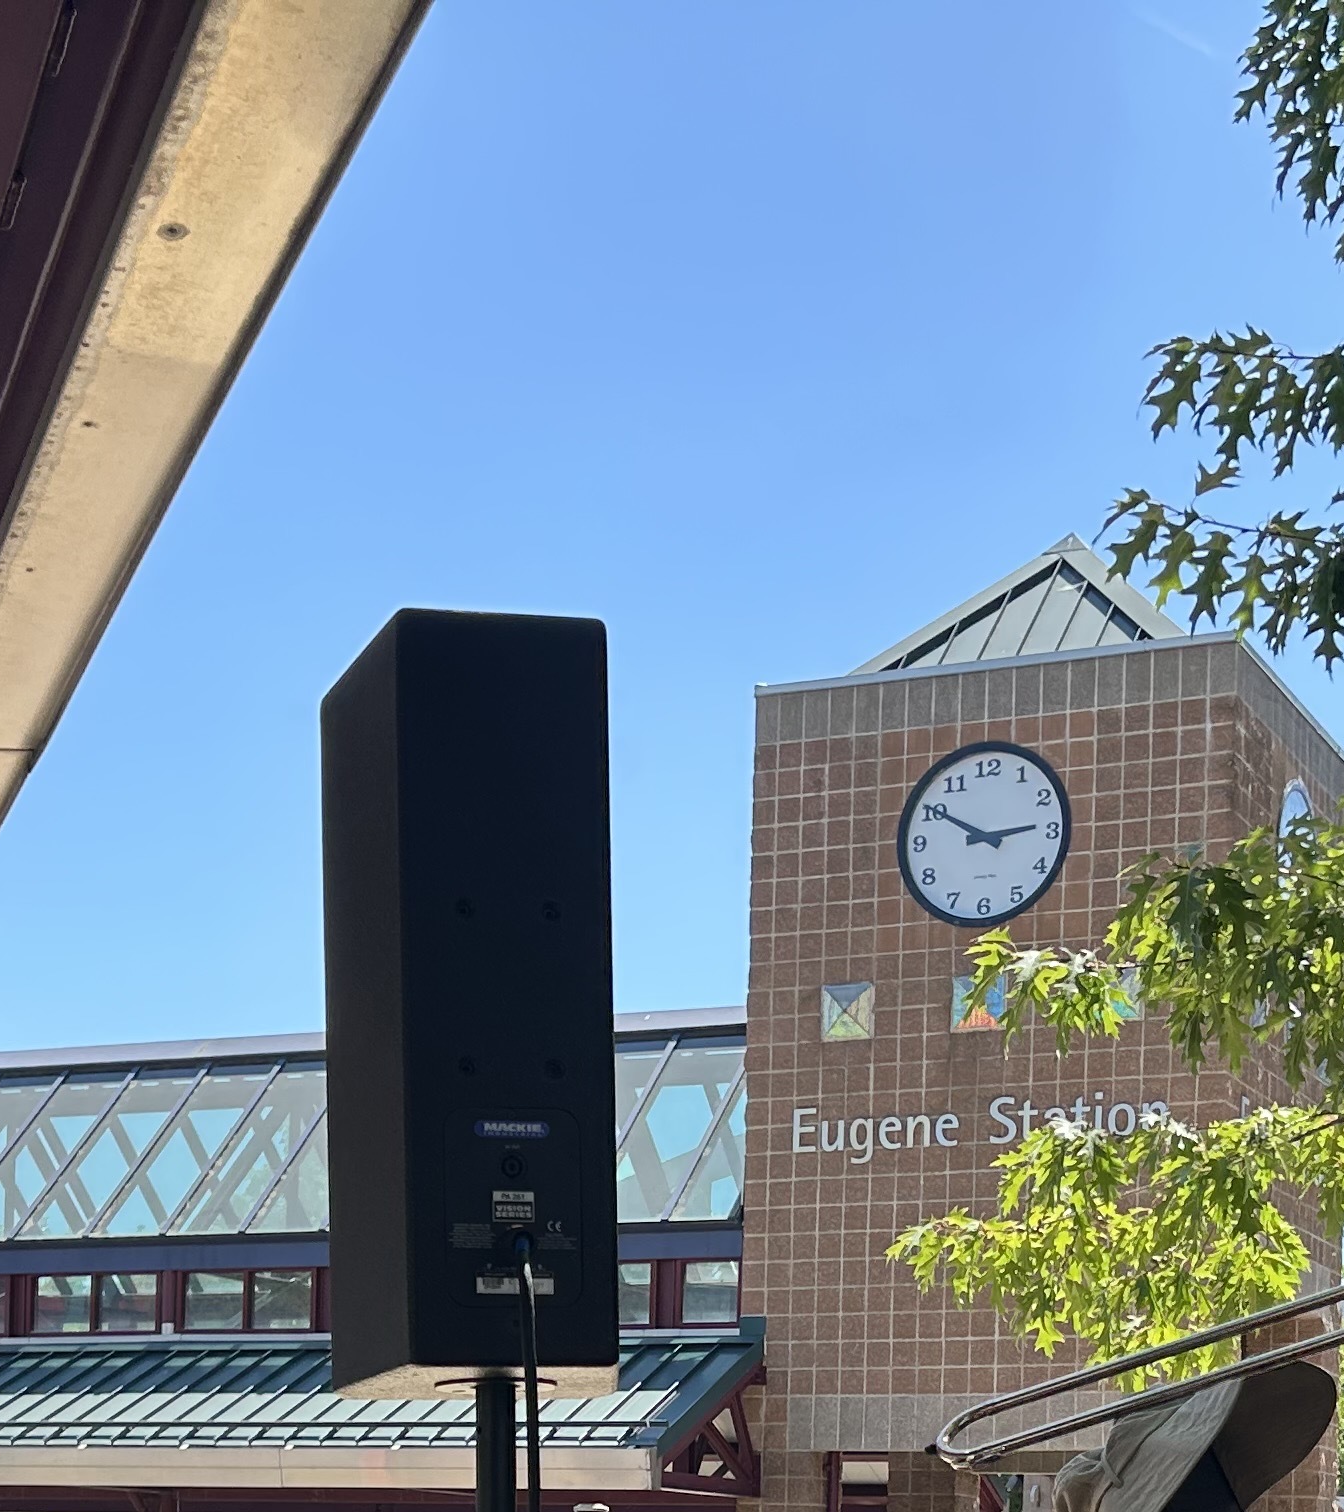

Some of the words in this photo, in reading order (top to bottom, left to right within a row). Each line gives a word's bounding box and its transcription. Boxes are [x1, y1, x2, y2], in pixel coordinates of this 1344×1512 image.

[974, 758, 1002, 778] 12
[1016, 765, 1028, 783] 1
[943, 774, 968, 794] 11
[1036, 788, 1052, 807] 2
[921, 803, 948, 822] 10
[1045, 822, 1060, 839] 3
[913, 835, 927, 852] 9
[1032, 856, 1048, 874] 4
[921, 868, 936, 885] 8
[946, 891, 961, 910] 7
[1009, 885, 1024, 903] 5
[976, 898, 991, 915] 6
[792, 1107, 960, 1165] Eugene
